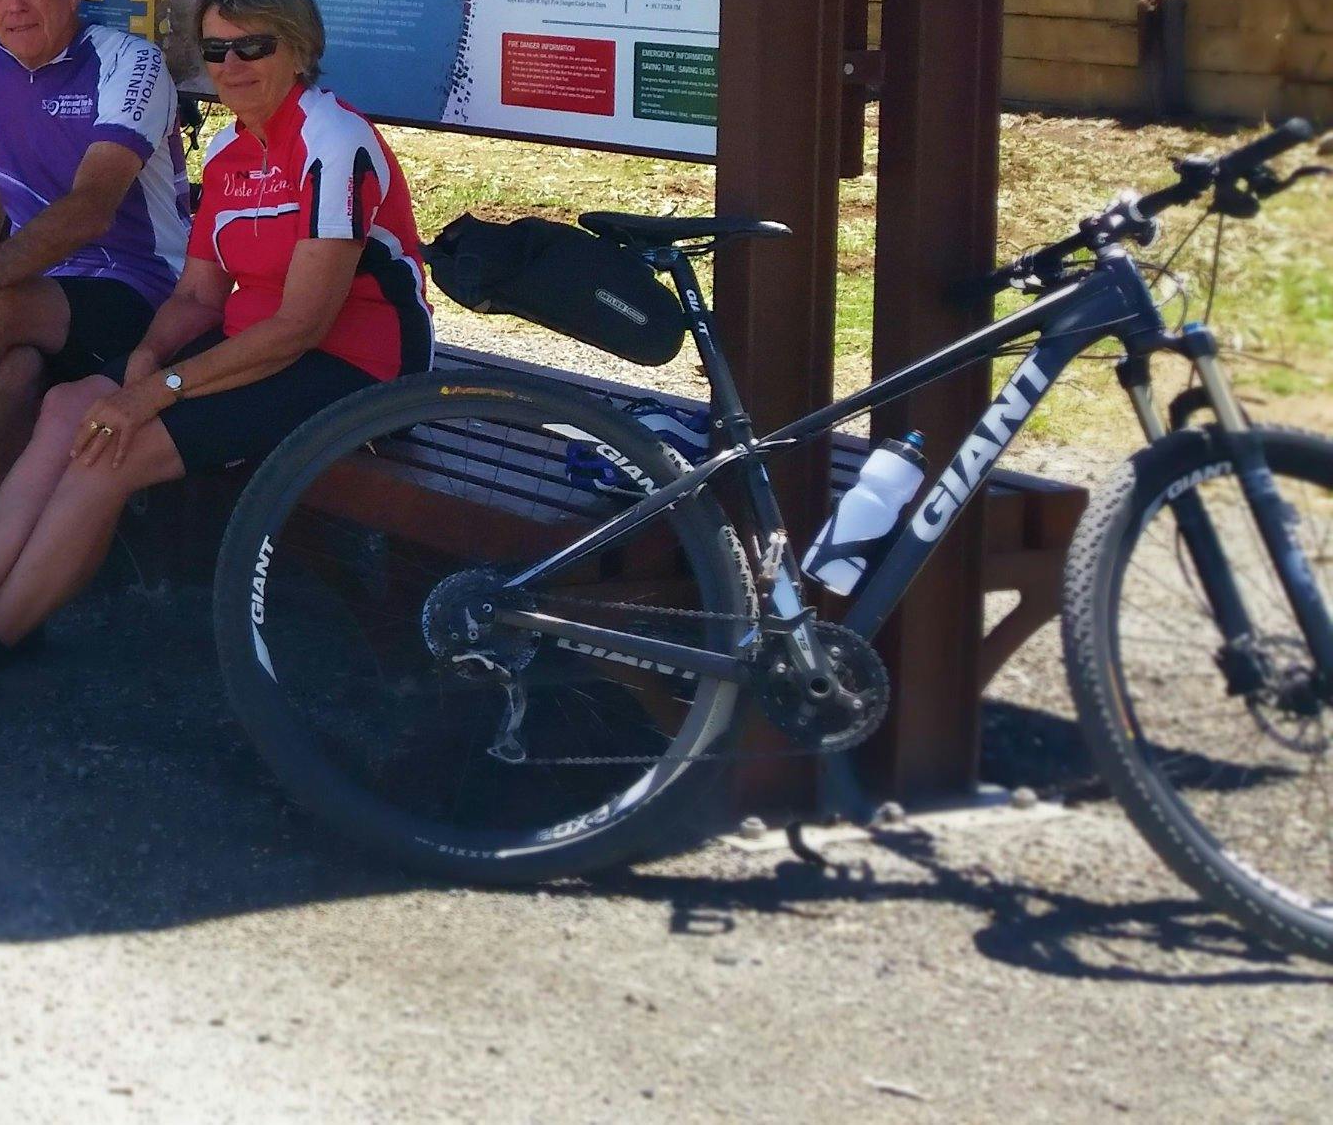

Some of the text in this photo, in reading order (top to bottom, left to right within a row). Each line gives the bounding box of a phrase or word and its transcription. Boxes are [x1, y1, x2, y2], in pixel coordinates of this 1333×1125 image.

[507, 40, 576, 52] FIRE DANGER INFORMATION
[641, 49, 714, 62] EMERGENCY INFORMATION
[641, 62, 661, 72] SAVING
[678, 65, 699, 75] SAVING
[699, 67, 716, 76] LIVES
[121, 49, 149, 114] PARTNERS
[911, 345, 1050, 543] GIANT
[595, 443, 661, 496] GIAN
[1167, 460, 1233, 500] GIANT
[250, 533, 275, 626] GIANT
